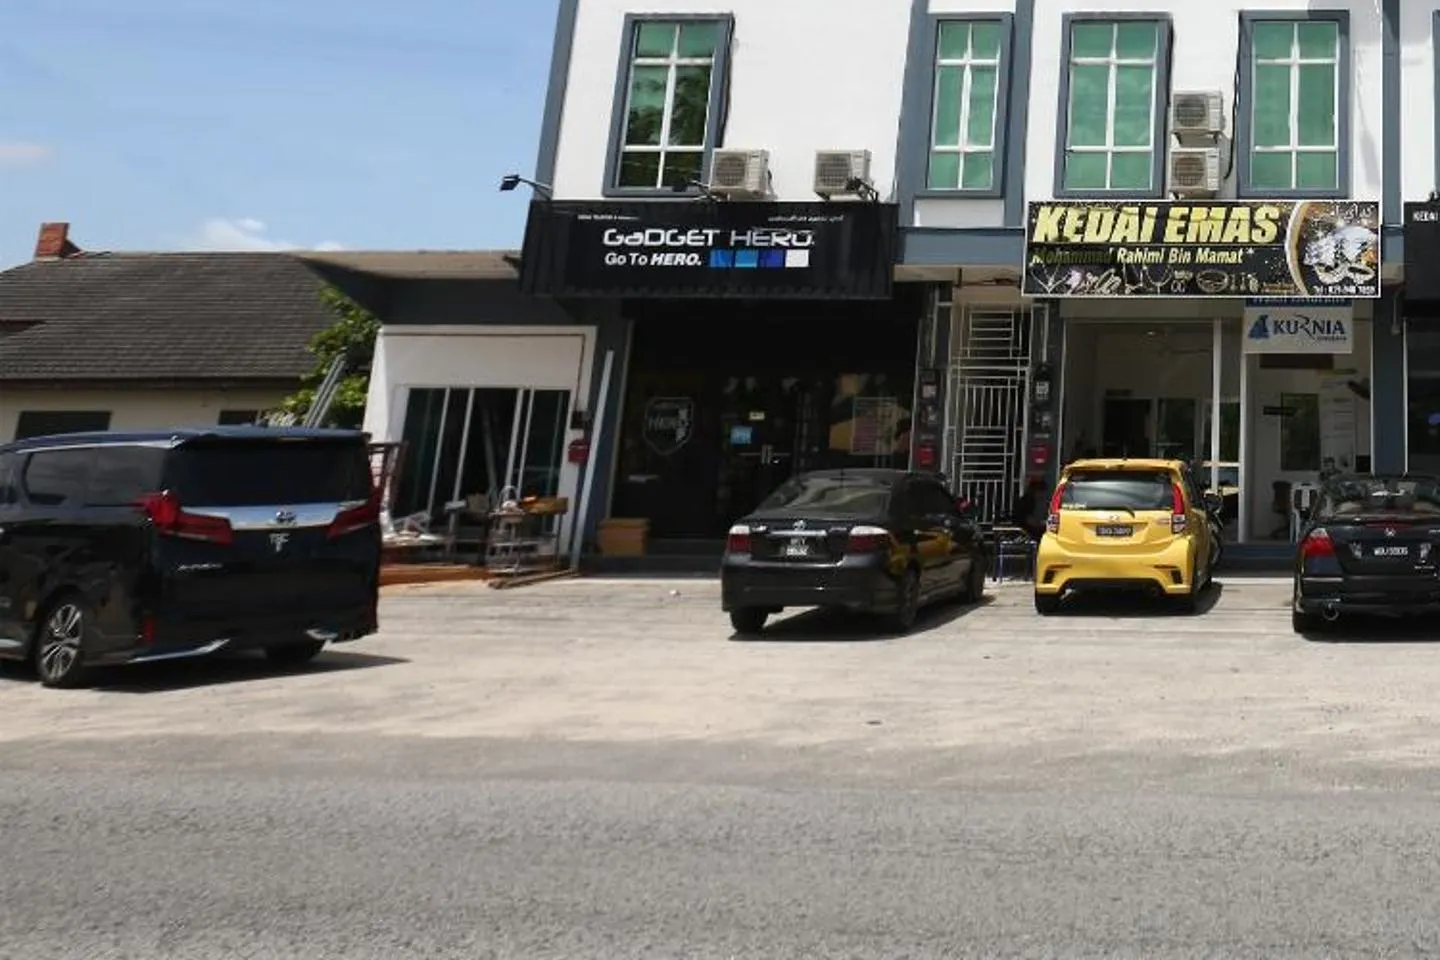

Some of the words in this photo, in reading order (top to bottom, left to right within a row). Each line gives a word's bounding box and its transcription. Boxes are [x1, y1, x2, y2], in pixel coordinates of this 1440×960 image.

[1032, 206, 1159, 243] KEDAI
[1163, 204, 1281, 243] EMAS
[604, 252, 627, 266] Go
[629, 252, 648, 266] To
[1168, 247, 1192, 264] Bin
[1195, 247, 1244, 264] Mamat
[1273, 315, 1346, 339] KURNIA
